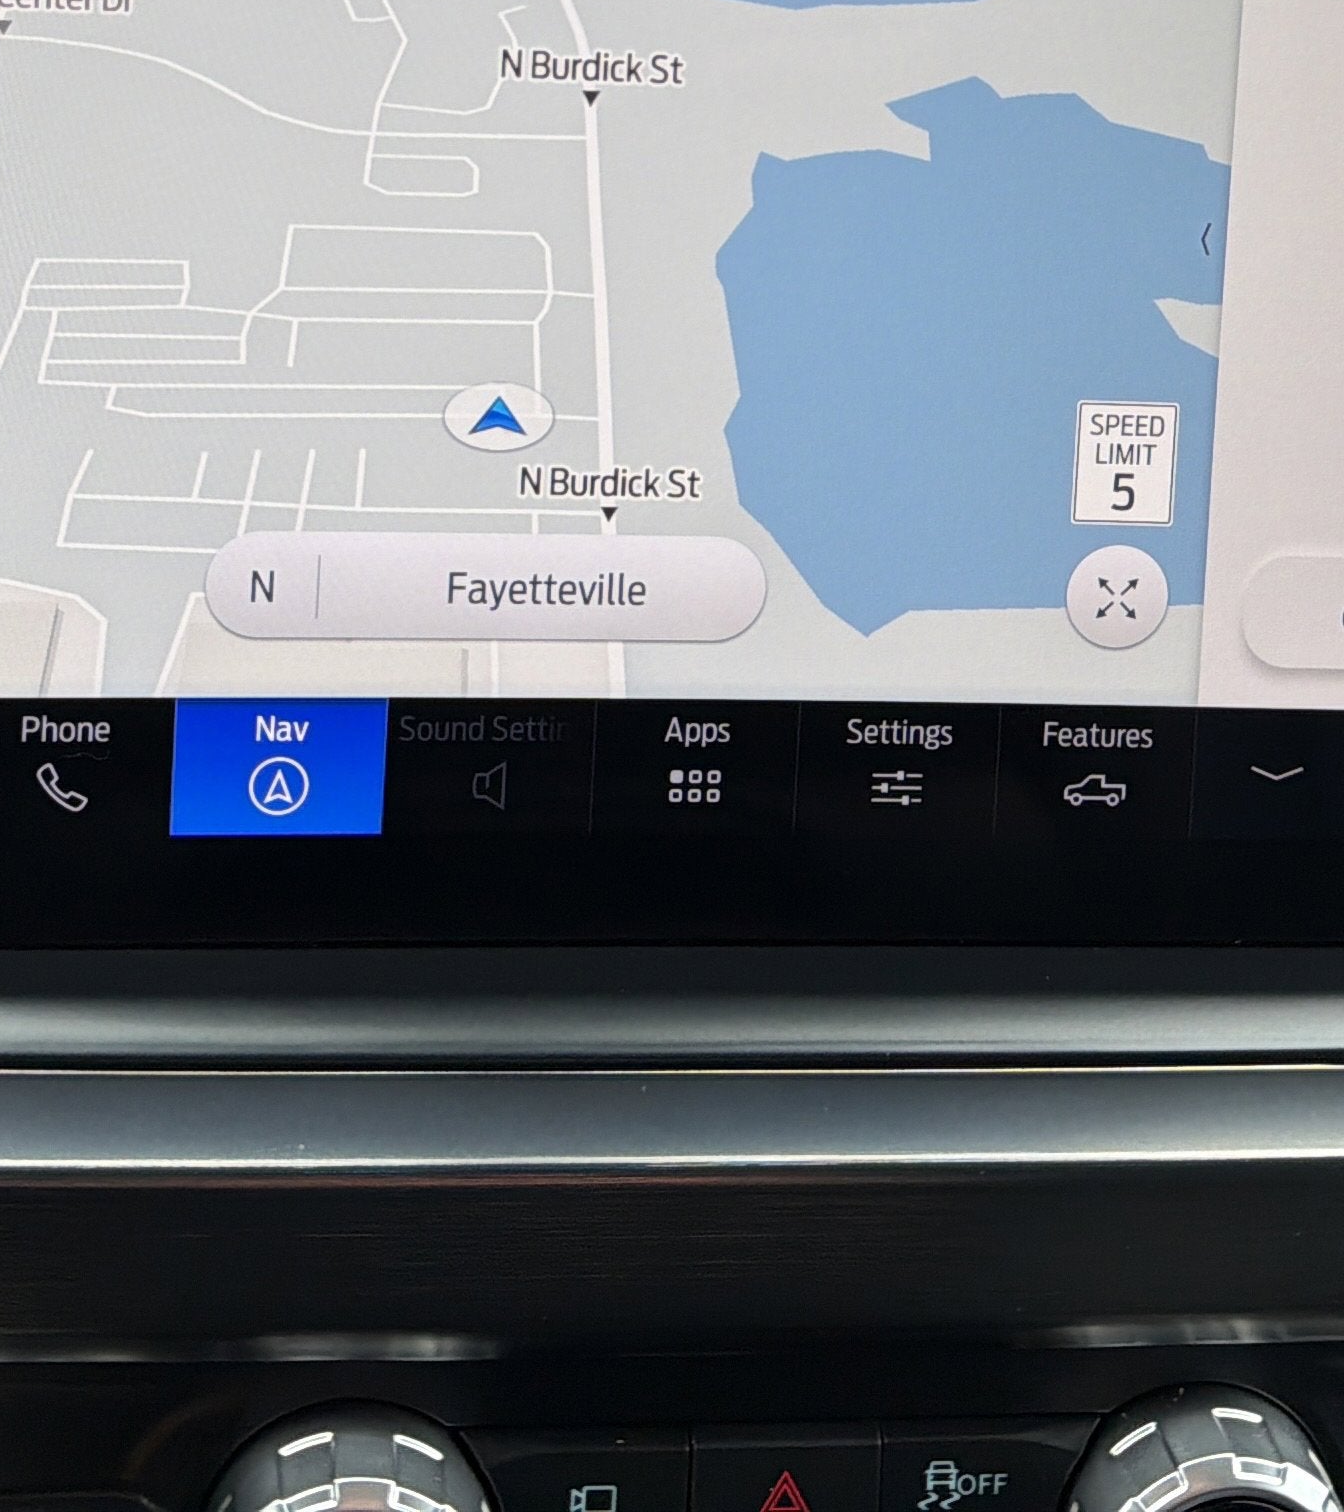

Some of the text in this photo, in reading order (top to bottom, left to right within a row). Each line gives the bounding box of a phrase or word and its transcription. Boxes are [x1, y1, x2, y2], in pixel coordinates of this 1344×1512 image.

[501, 48, 684, 86] N Burdick St
[1090, 414, 1166, 438] SPEED
[1095, 443, 1158, 467] LIMIT
[519, 467, 701, 499] N Burdick St
[1112, 472, 1136, 512] 5
[250, 570, 647, 611] N Fayetteville
[20, 715, 111, 743] Phone
[255, 715, 309, 742] Nav
[400, 715, 485, 742] Sound
[665, 717, 731, 750] Apps
[846, 718, 954, 750] Settings
[1043, 721, 1154, 750] Features
[957, 1473, 1008, 1496] OFF
